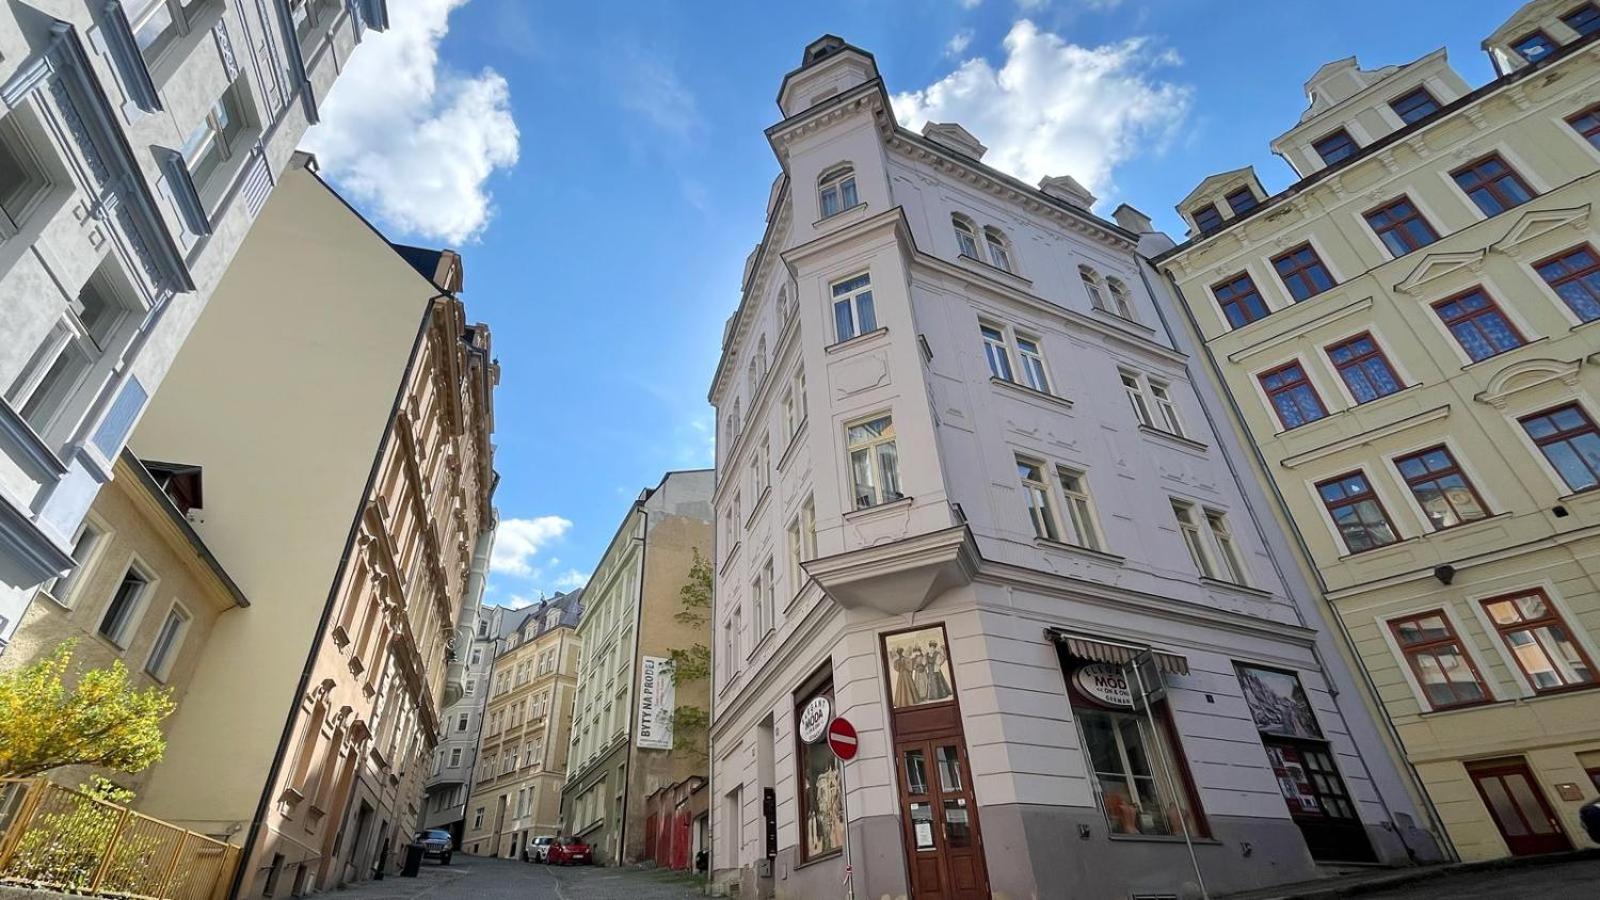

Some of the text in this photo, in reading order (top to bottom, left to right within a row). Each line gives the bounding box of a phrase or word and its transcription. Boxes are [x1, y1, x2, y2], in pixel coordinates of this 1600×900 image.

[641, 660, 654, 737] BYTY NA PRODEJ
